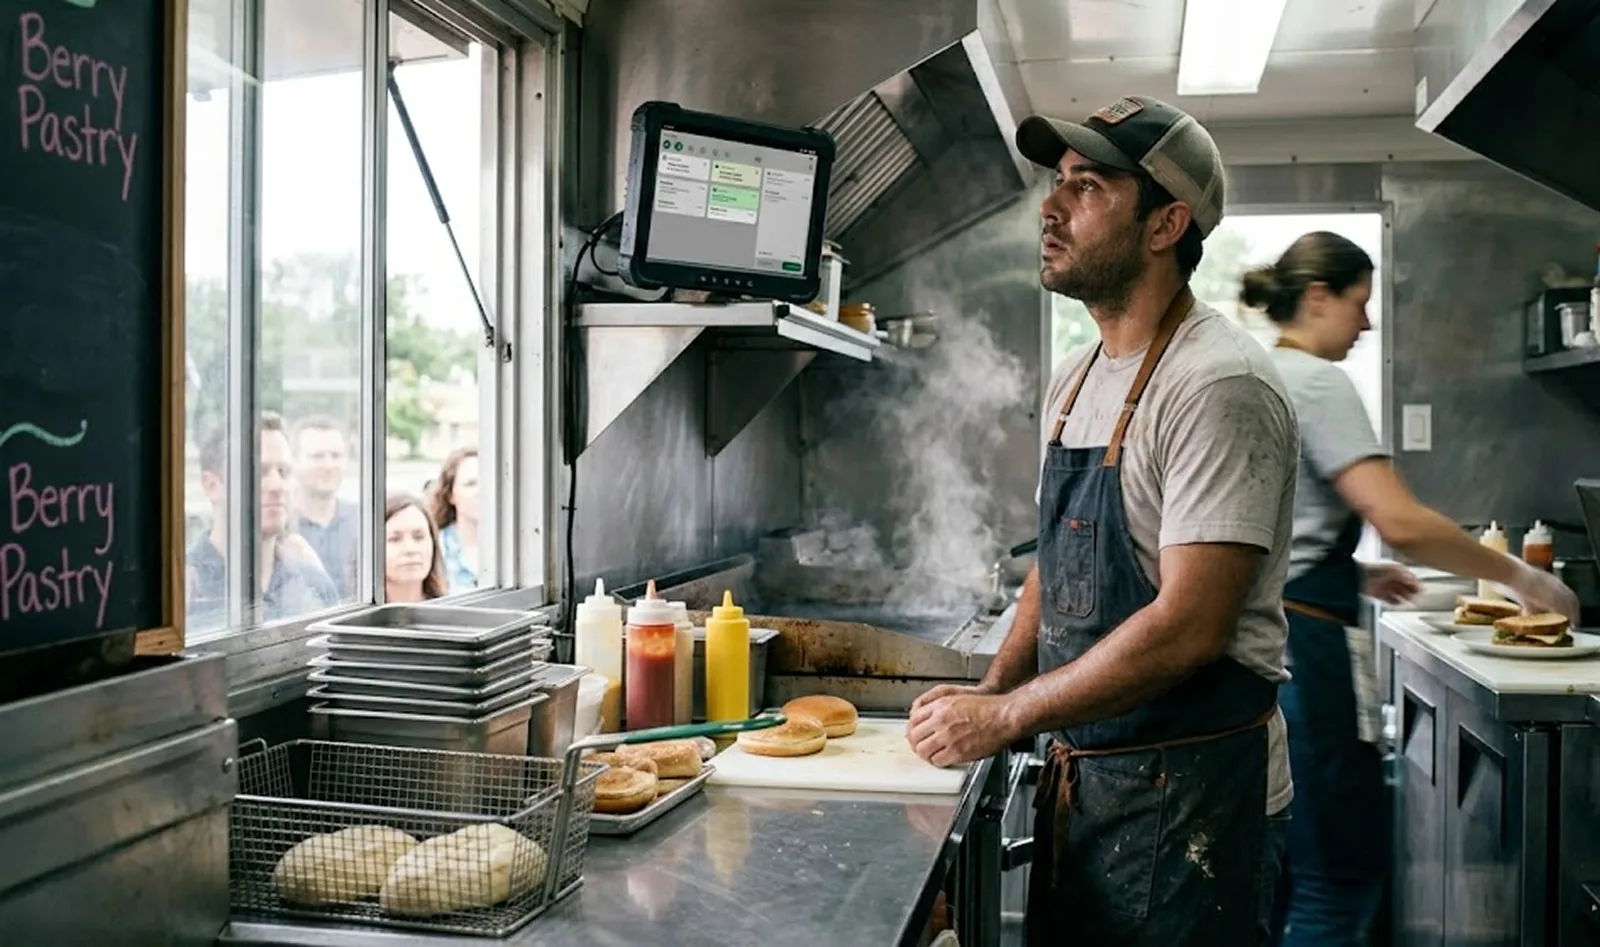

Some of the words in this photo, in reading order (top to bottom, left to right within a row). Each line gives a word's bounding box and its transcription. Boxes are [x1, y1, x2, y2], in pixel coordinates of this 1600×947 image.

[19, 12, 127, 131] Berry
[18, 84, 137, 201] Pastry
[9, 462, 114, 555] Berry
[0, 543, 113, 628] Pastry
